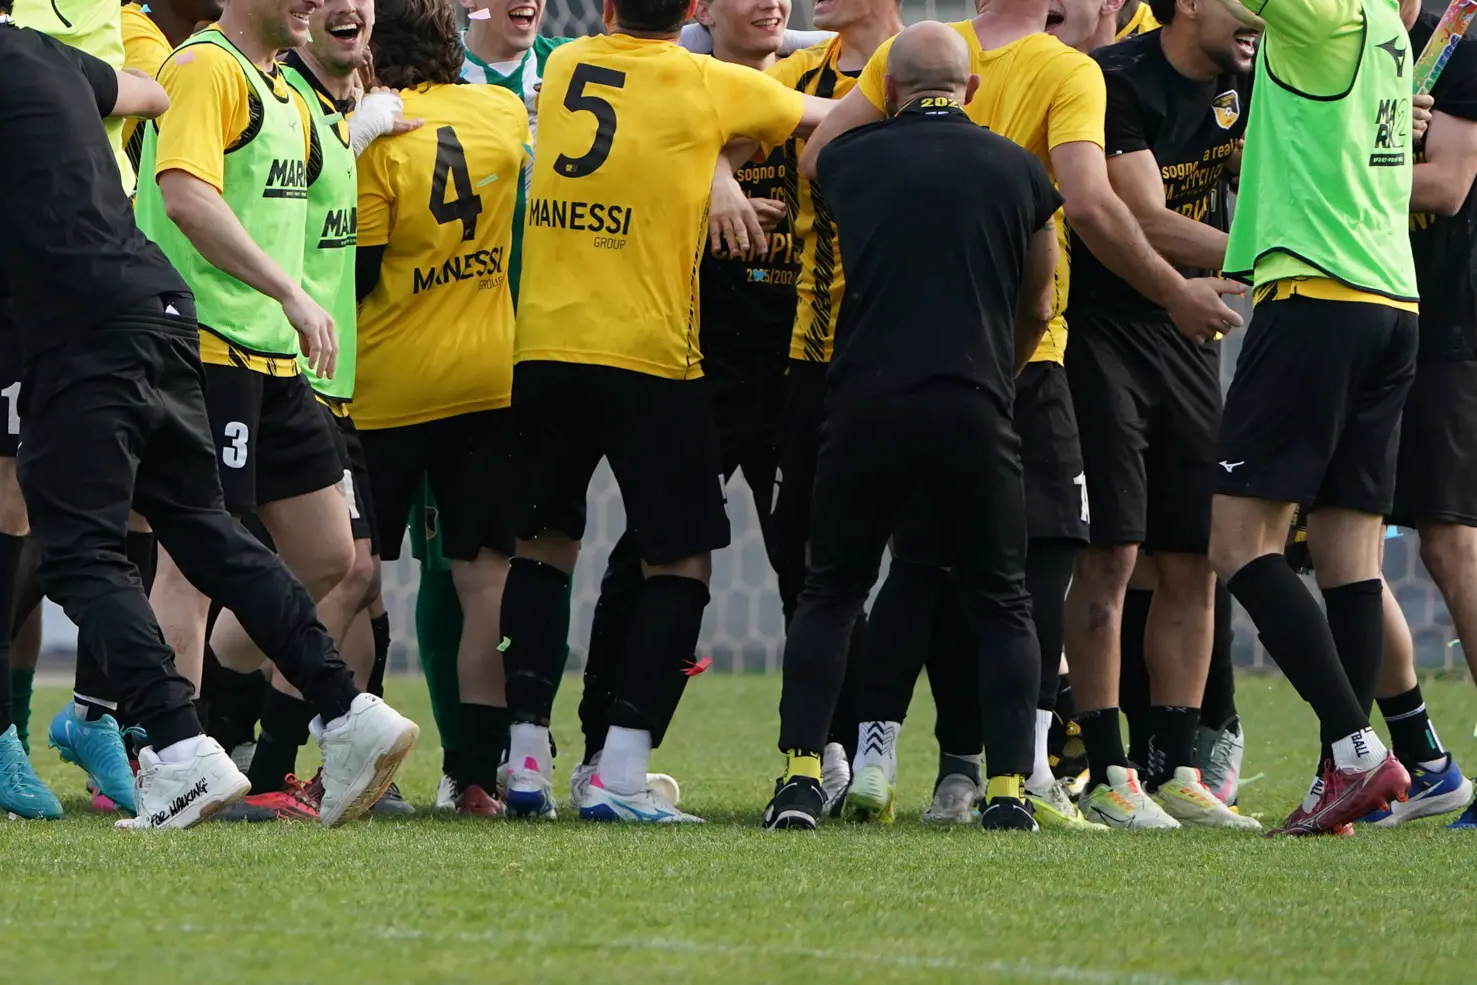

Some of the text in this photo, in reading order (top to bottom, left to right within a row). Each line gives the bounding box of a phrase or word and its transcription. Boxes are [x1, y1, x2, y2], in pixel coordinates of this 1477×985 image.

[553, 62, 626, 178] 5
[265, 158, 308, 188] MAR
[429, 125, 483, 243] 4
[737, 167, 775, 185] sogno
[529, 198, 633, 236] MANESSI
[593, 236, 627, 251] GROUP
[222, 421, 249, 469] 3
[1351, 731, 1370, 758] BALL
